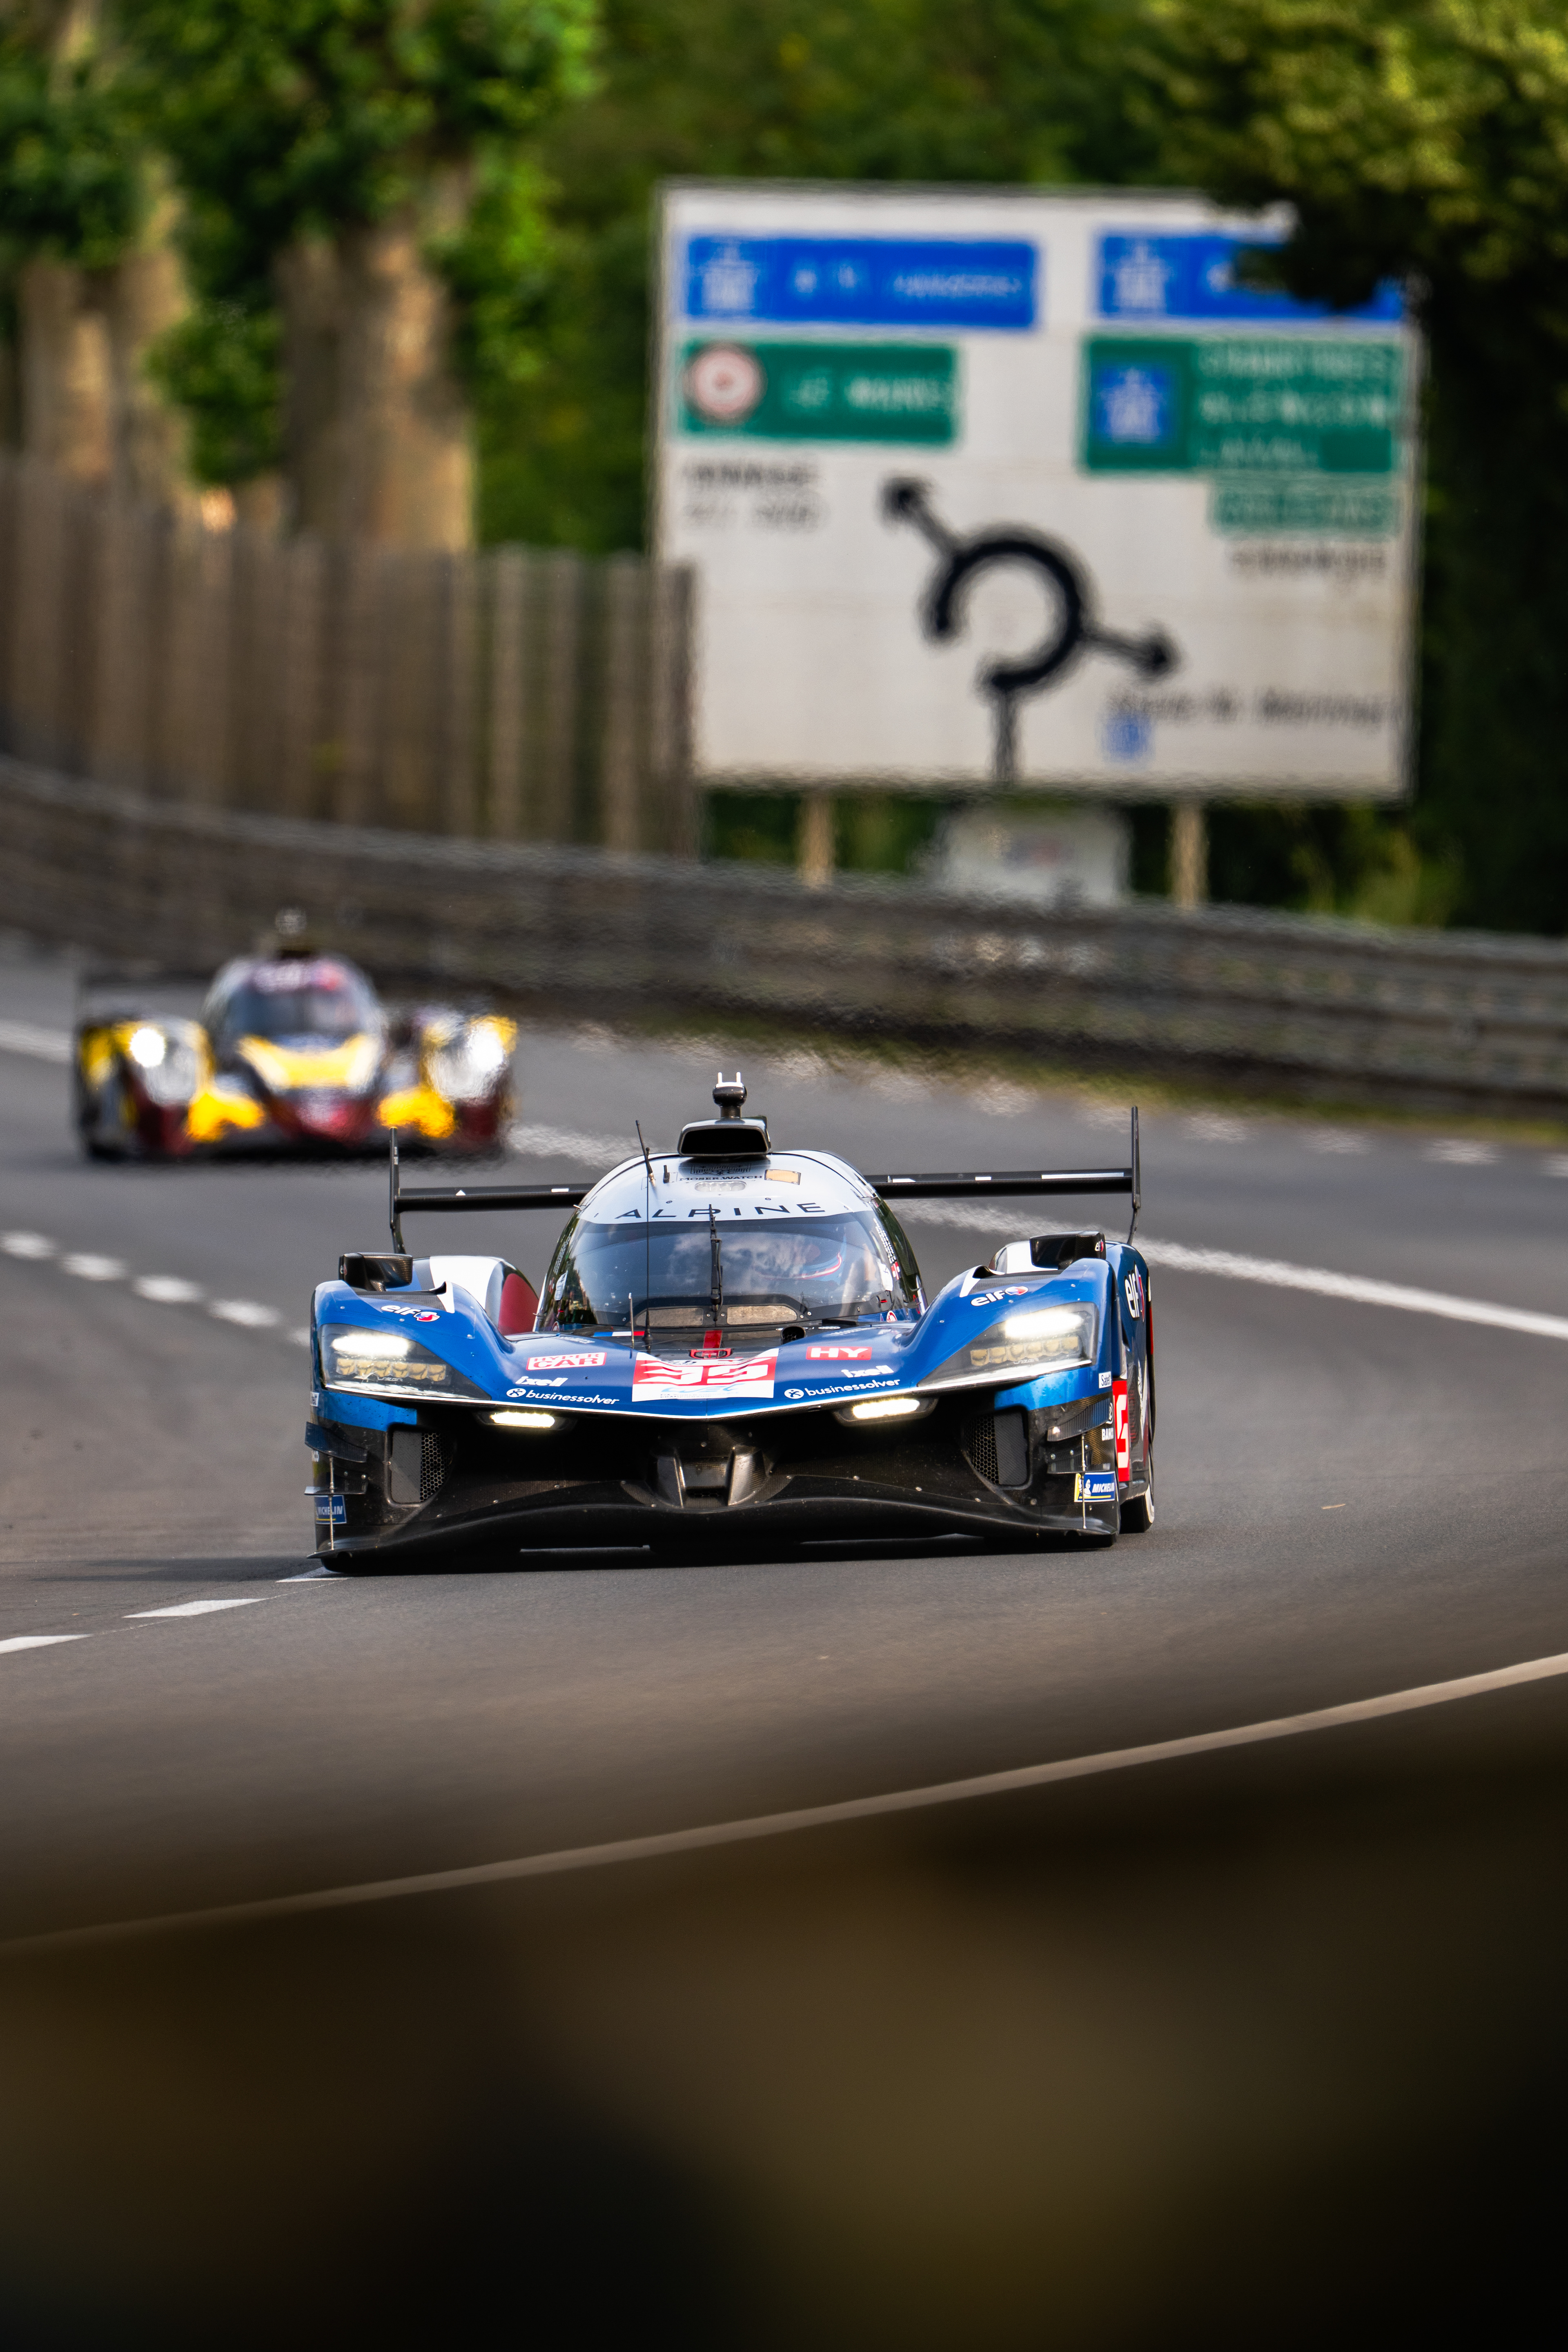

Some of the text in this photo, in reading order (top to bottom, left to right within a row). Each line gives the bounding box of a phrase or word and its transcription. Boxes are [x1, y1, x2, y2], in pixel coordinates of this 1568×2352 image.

[615, 1202, 825, 1219] ALPINE
[970, 1290, 1006, 1306] elf
[1125, 1273, 1140, 1318] elf
[381, 1305, 421, 1316] elf
[534, 1354, 599, 1362] HYPER
[811, 1348, 869, 1358] HY
[533, 1358, 598, 1368] CAR
[841, 1365, 894, 1378] ixell
[515, 1376, 568, 1387] ixell
[804, 1379, 900, 1396] businessolver
[526, 1390, 620, 1405] businessolver
[1091, 1482, 1115, 1493] MICHELIN
